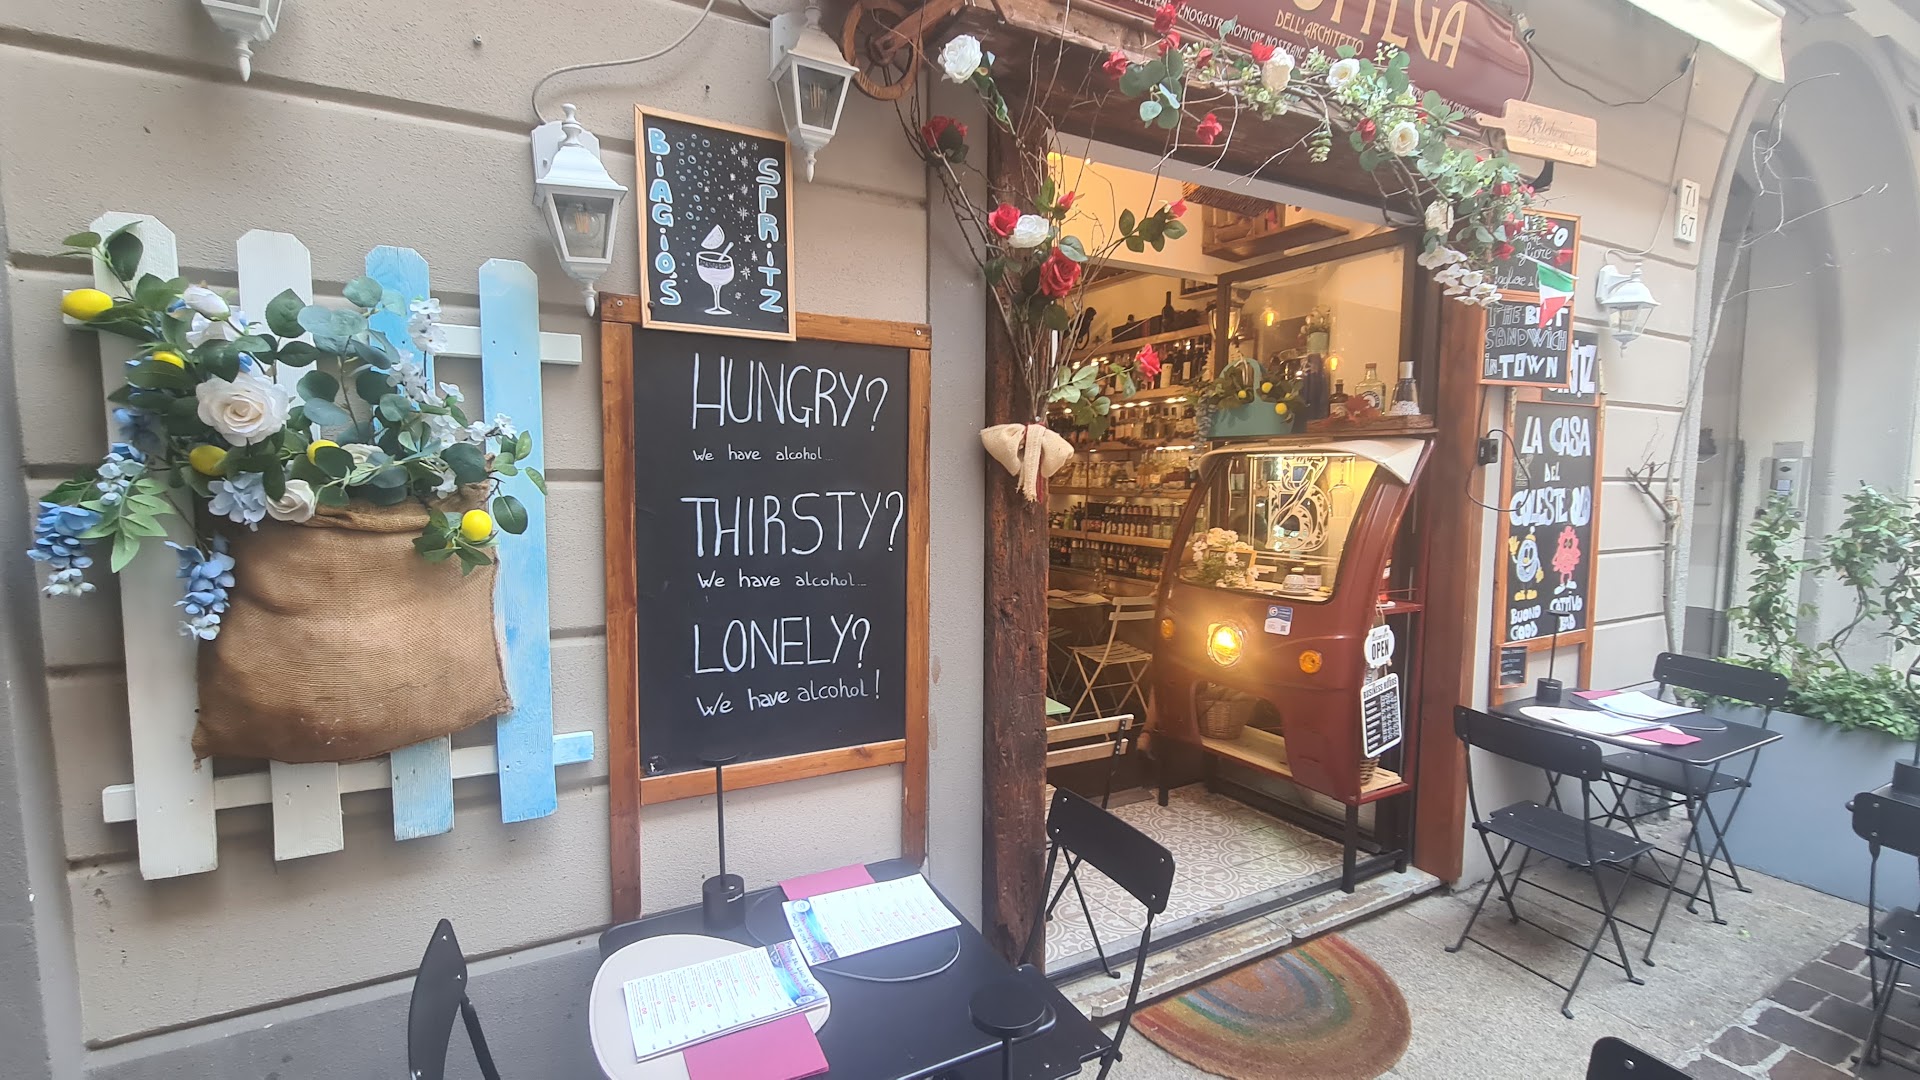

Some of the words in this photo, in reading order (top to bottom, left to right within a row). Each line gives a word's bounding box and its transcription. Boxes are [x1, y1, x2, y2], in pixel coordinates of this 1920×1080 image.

[1685, 184, 1696, 207] 71
[1681, 214, 1695, 237] 67
[692, 352, 889, 432] HUNGRY?
[1521, 415, 1543, 454] LA
[1549, 415, 1592, 457] CASA
[727, 443, 762, 461] have
[1544, 461, 1560, 482] DEL
[680, 490, 904, 557] THIRSTY?
[697, 570, 726, 589] We
[738, 568, 781, 588] have
[1510, 604, 1542, 625] BUONO
[1510, 621, 1539, 641] GOOD
[693, 613, 871, 674] LONELY?
[1371, 638, 1390, 661] OPEN
[696, 691, 734, 717] We
[747, 687, 791, 712] have
